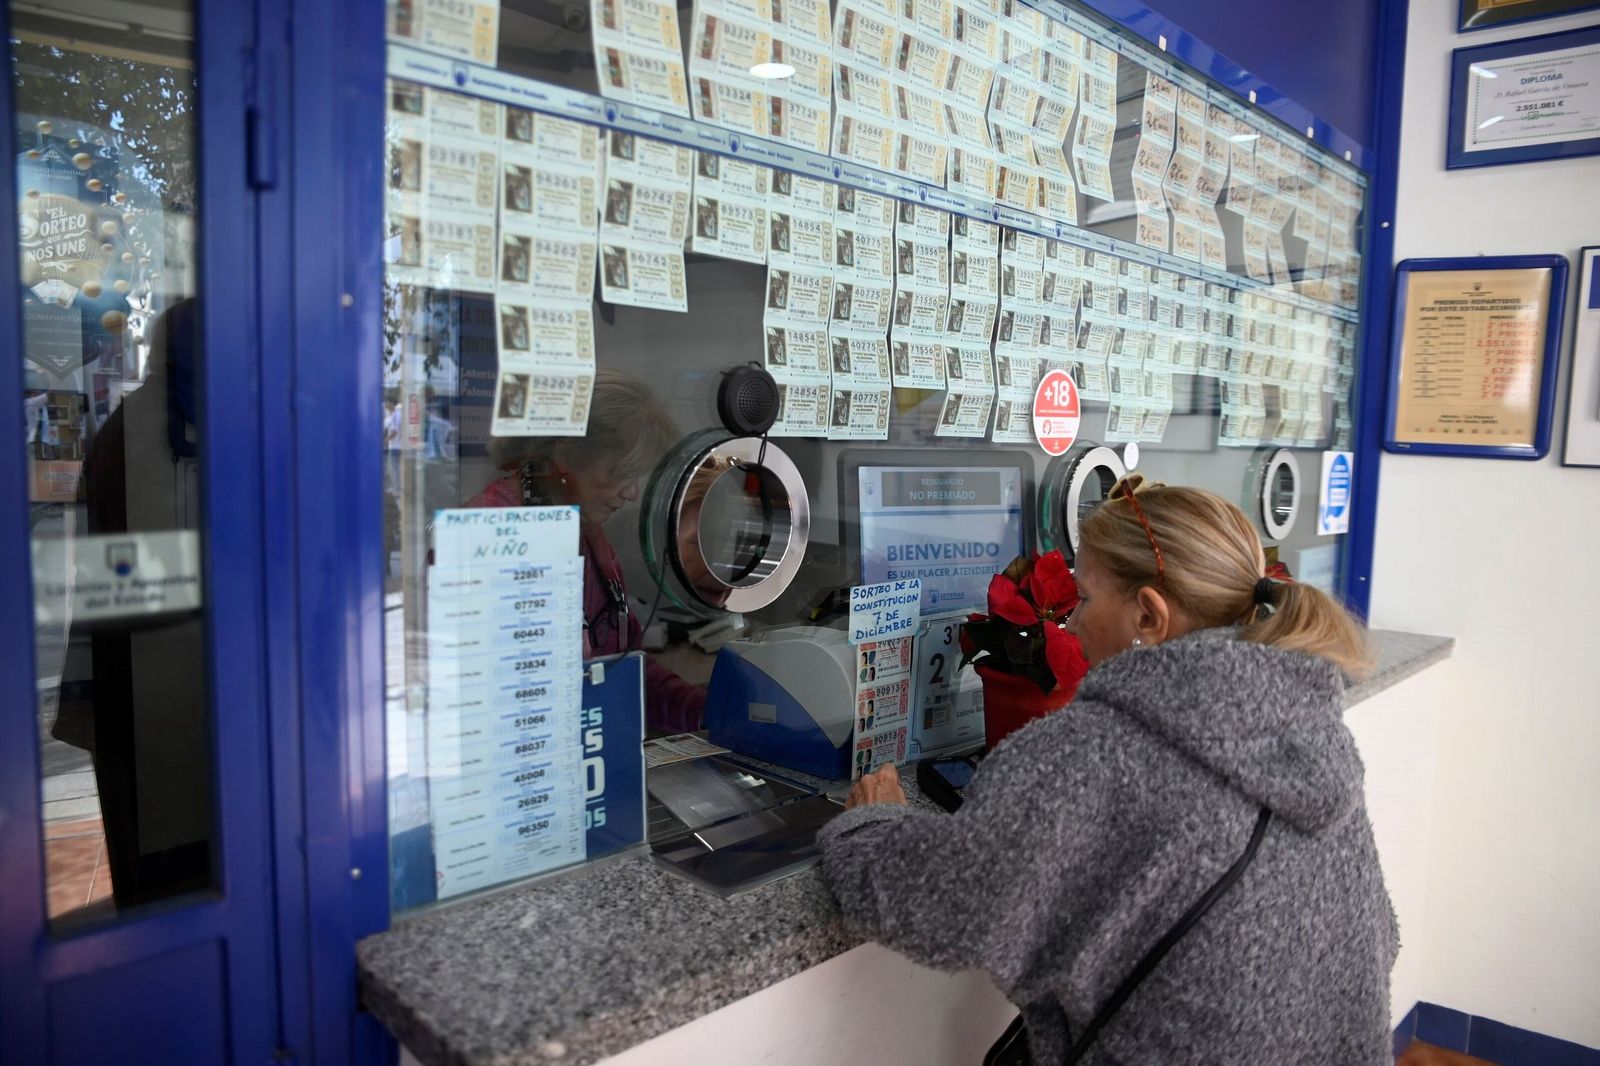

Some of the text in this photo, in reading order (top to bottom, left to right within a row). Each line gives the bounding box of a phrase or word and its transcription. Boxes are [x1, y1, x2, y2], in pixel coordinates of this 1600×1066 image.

[1520, 73, 1564, 85] DIPLOMA
[46, 206, 67, 220] EL
[24, 239, 87, 262] NOS UNE
[851, 341, 877, 352] 40775
[853, 393, 879, 403] 40775
[1043, 380, 1070, 407] +18
[921, 478, 964, 486] RESGUARDO
[909, 490, 976, 501] NO PREMIADO
[446, 510, 572, 525] PARTICIPACIONES
[496, 527, 520, 537] DEL
[474, 539, 529, 558] NIÑO
[886, 541, 1000, 562] BIENVENIDO
[887, 565, 1000, 580] ES UN PLACER ATENDERLE
[852, 579, 920, 600] SORTEO DE LA
[514, 599, 546, 610] 07792
[872, 609, 899, 625] 7 DE
[513, 627, 545, 640] 60443
[855, 617, 912, 640] DICIEMBRE
[876, 683, 900, 697] 90913
[514, 714, 546, 728] 51066
[872, 731, 898, 746] 90913
[517, 793, 549, 808] 26929
[517, 820, 549, 836] 96350
